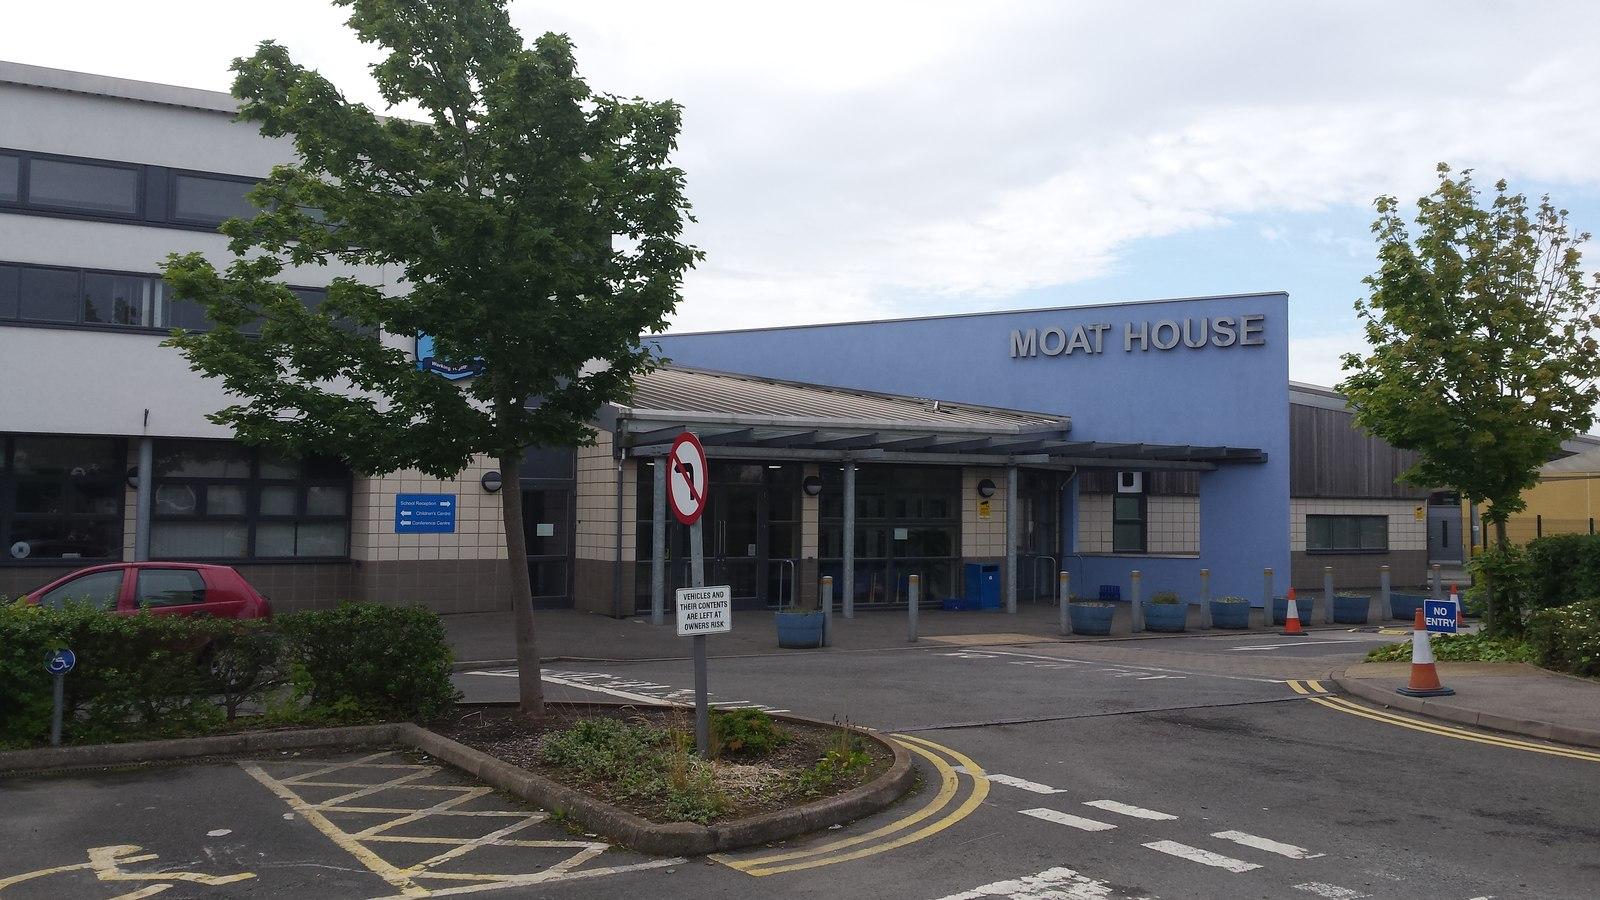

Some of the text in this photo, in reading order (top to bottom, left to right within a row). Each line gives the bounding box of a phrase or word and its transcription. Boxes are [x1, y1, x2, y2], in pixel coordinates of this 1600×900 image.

[1009, 314, 1265, 358] MOAT HOUSE
[683, 591, 724, 600] VEHICLES AND
[698, 601, 727, 609] CONTENTS
[1433, 607, 1447, 616] NO
[684, 622, 709, 631] OWNERS
[1425, 617, 1455, 628] ENTRY
